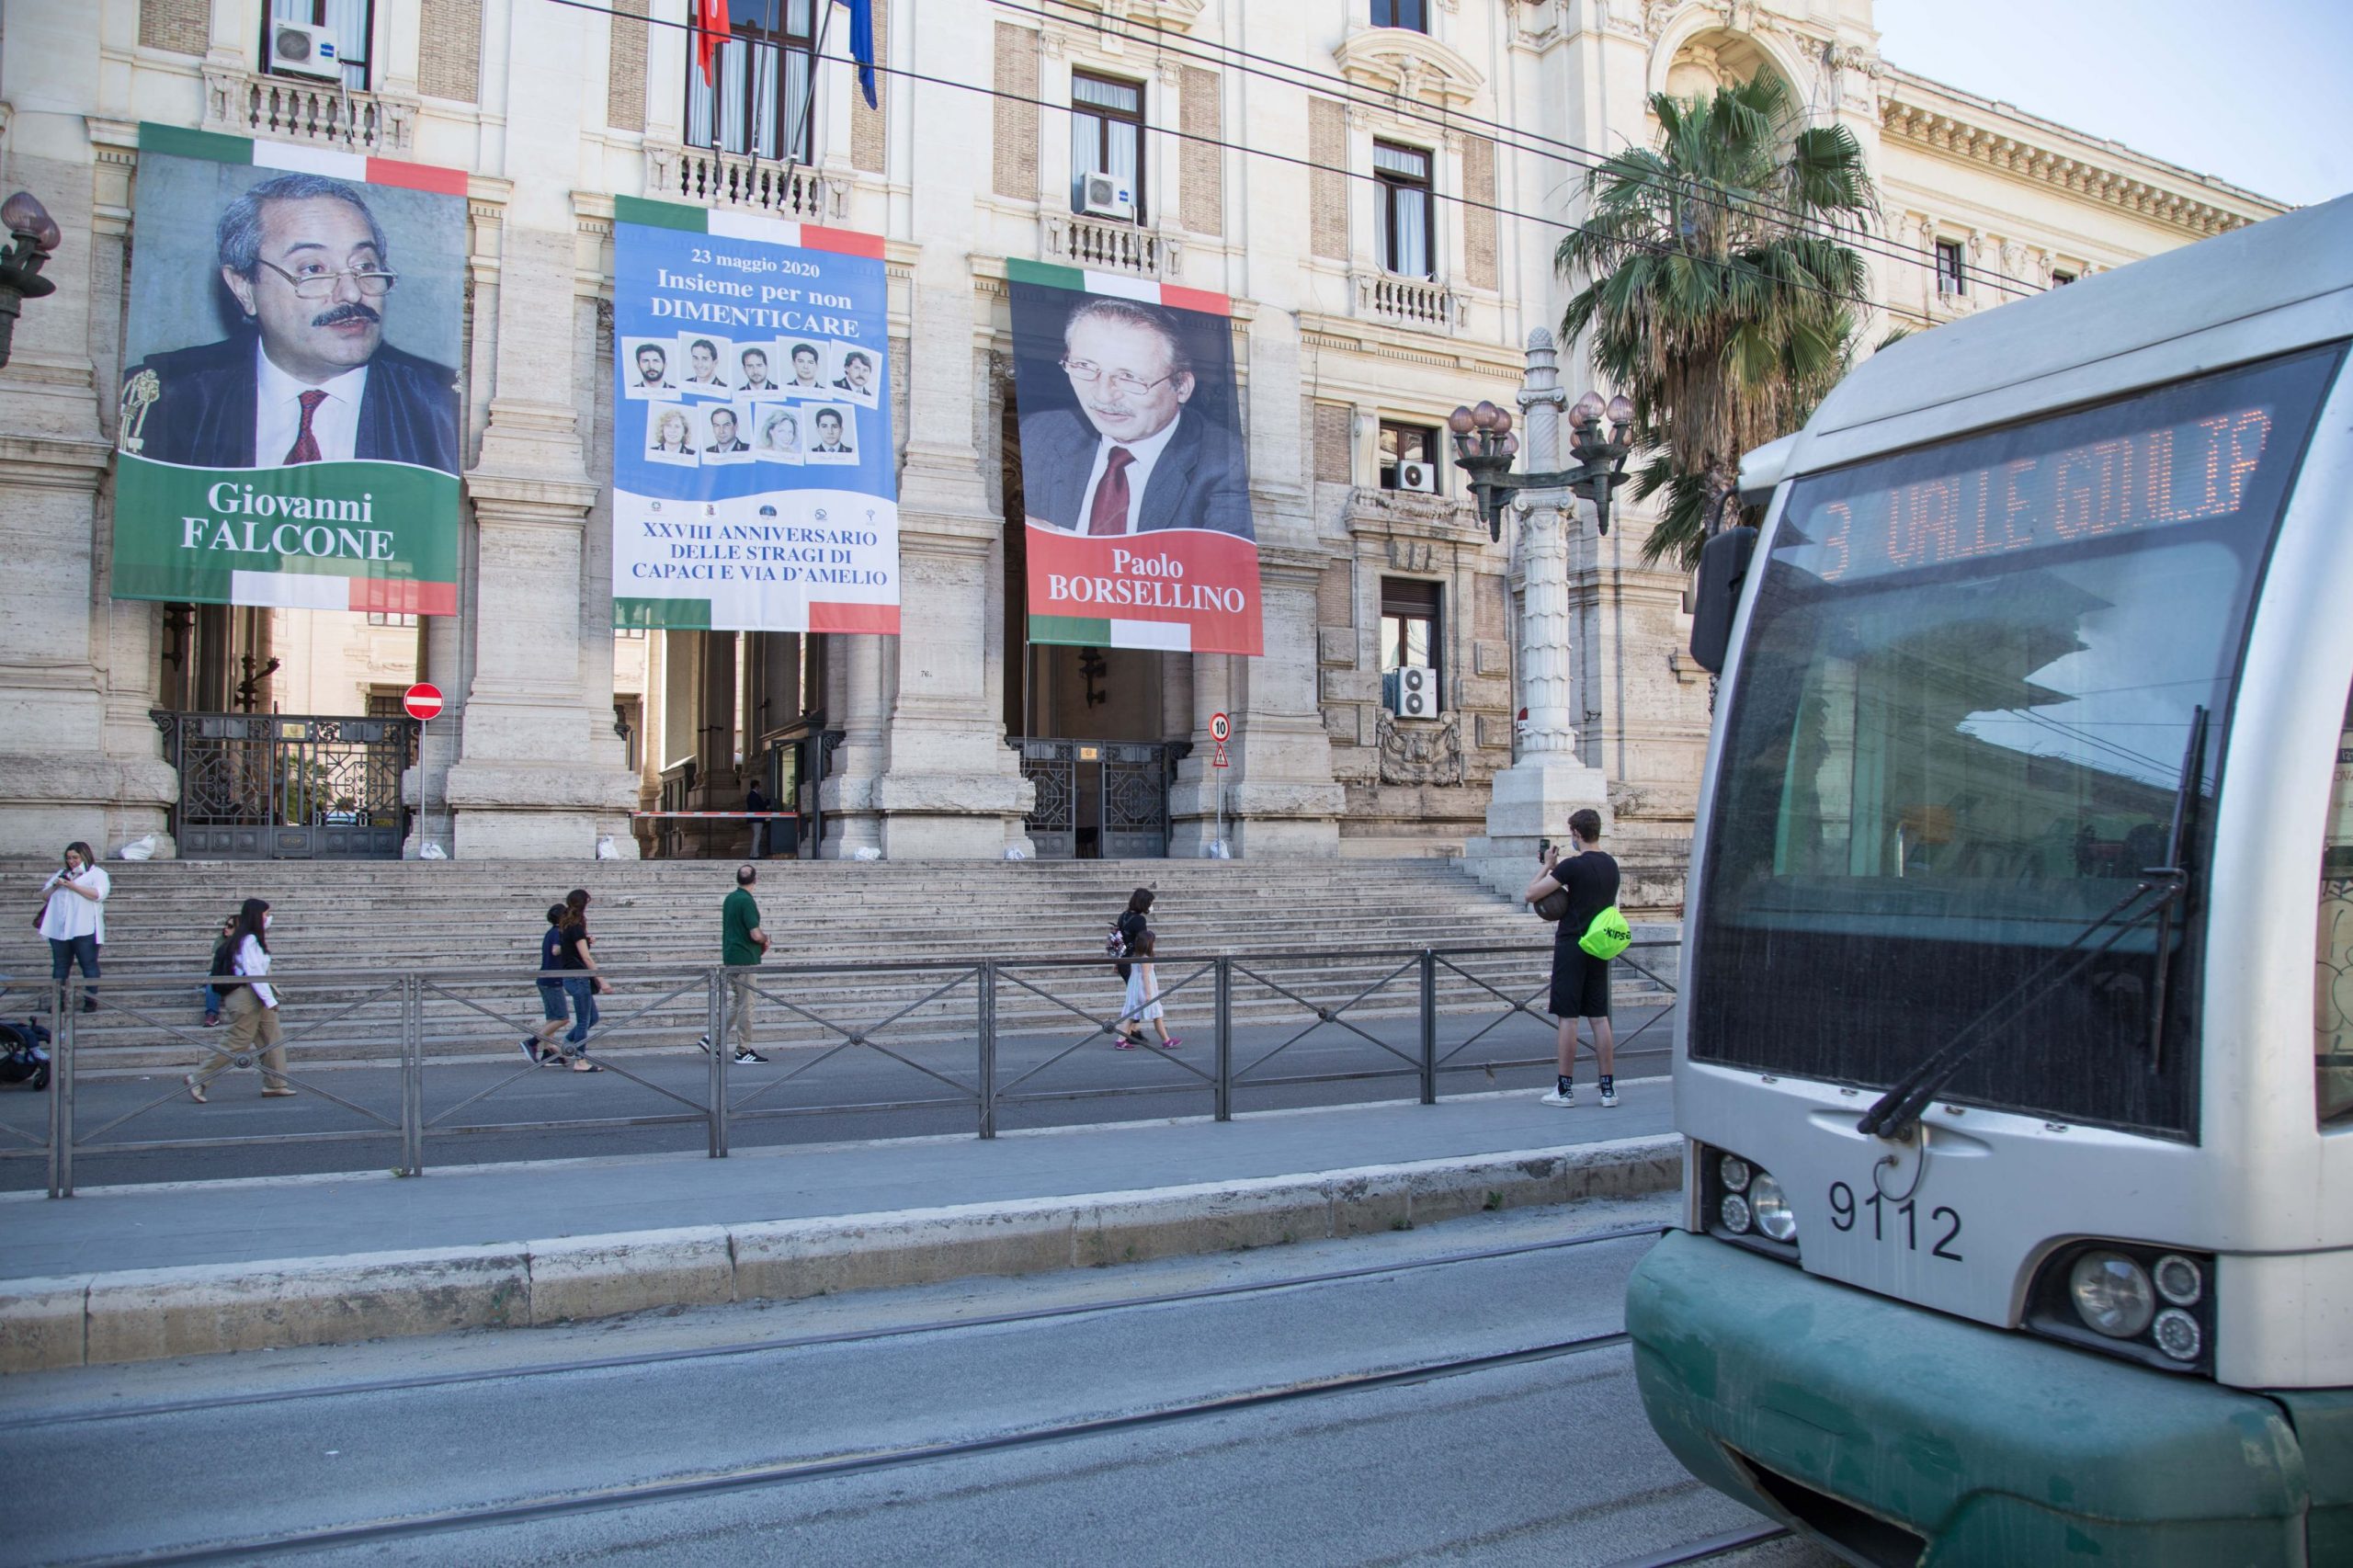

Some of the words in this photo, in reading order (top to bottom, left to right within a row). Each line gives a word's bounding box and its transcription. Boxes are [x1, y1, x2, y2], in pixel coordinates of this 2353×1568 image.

[691, 248, 711, 264] 23
[716, 253, 777, 273] maggio
[782, 260, 820, 278] 2020
[657, 269, 754, 298] Insieme
[761, 285, 801, 303] per
[809, 293, 852, 311] non
[651, 297, 859, 338] DIMENTICARE
[208, 482, 372, 523] Giovanni
[180, 517, 394, 561] FALCONE
[643, 522, 711, 540] XXVIII
[719, 525, 877, 546] ANNIVERSARIO
[671, 544, 741, 560] DELLE
[746, 545, 824, 563] STRAGI
[831, 549, 851, 563] DI
[1823, 503, 1851, 581] 3
[632, 562, 714, 579] CAPACI
[721, 565, 734, 579] E
[740, 565, 776, 581] VIA
[783, 567, 888, 585] D’AMELIO
[1111, 549, 1183, 578] Paolo
[1048, 574, 1245, 613] BORSELLINO
[1216, 721, 1226, 735] 10
[1829, 1181, 1962, 1262] 9112
